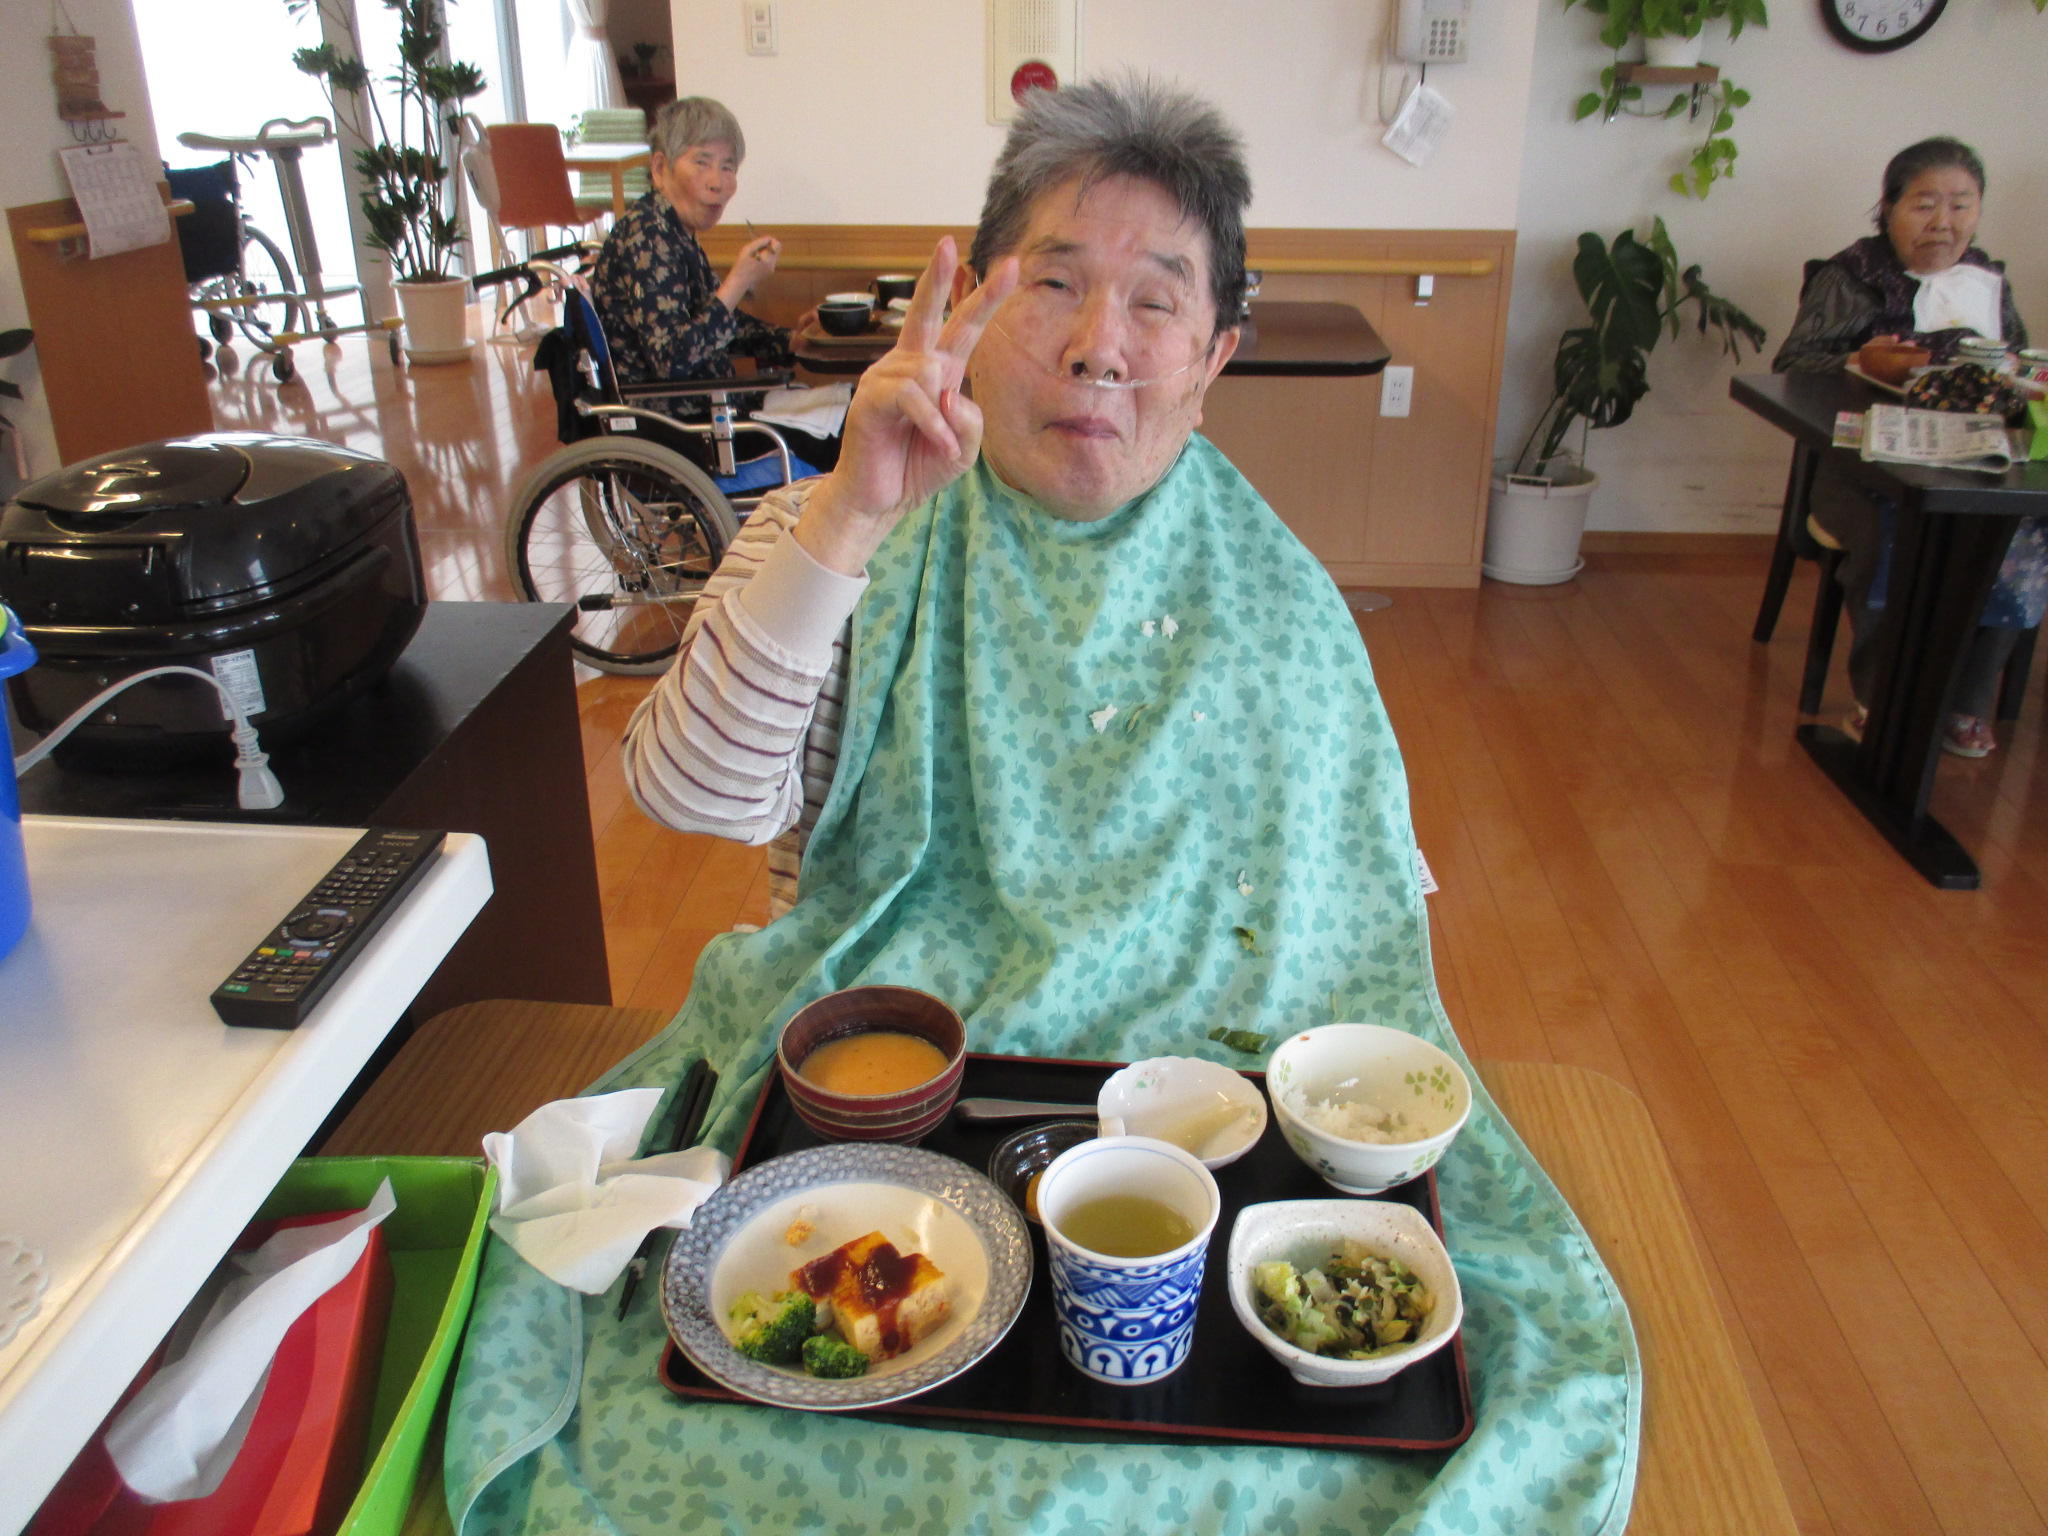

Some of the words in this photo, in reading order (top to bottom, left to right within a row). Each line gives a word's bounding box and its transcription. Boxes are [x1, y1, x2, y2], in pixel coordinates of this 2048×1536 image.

[1844, 1, 1856, 17] 8
[1858, 15, 1869, 32] 7
[1876, 18, 1888, 34] 6
[1898, 12, 1909, 28] 5
